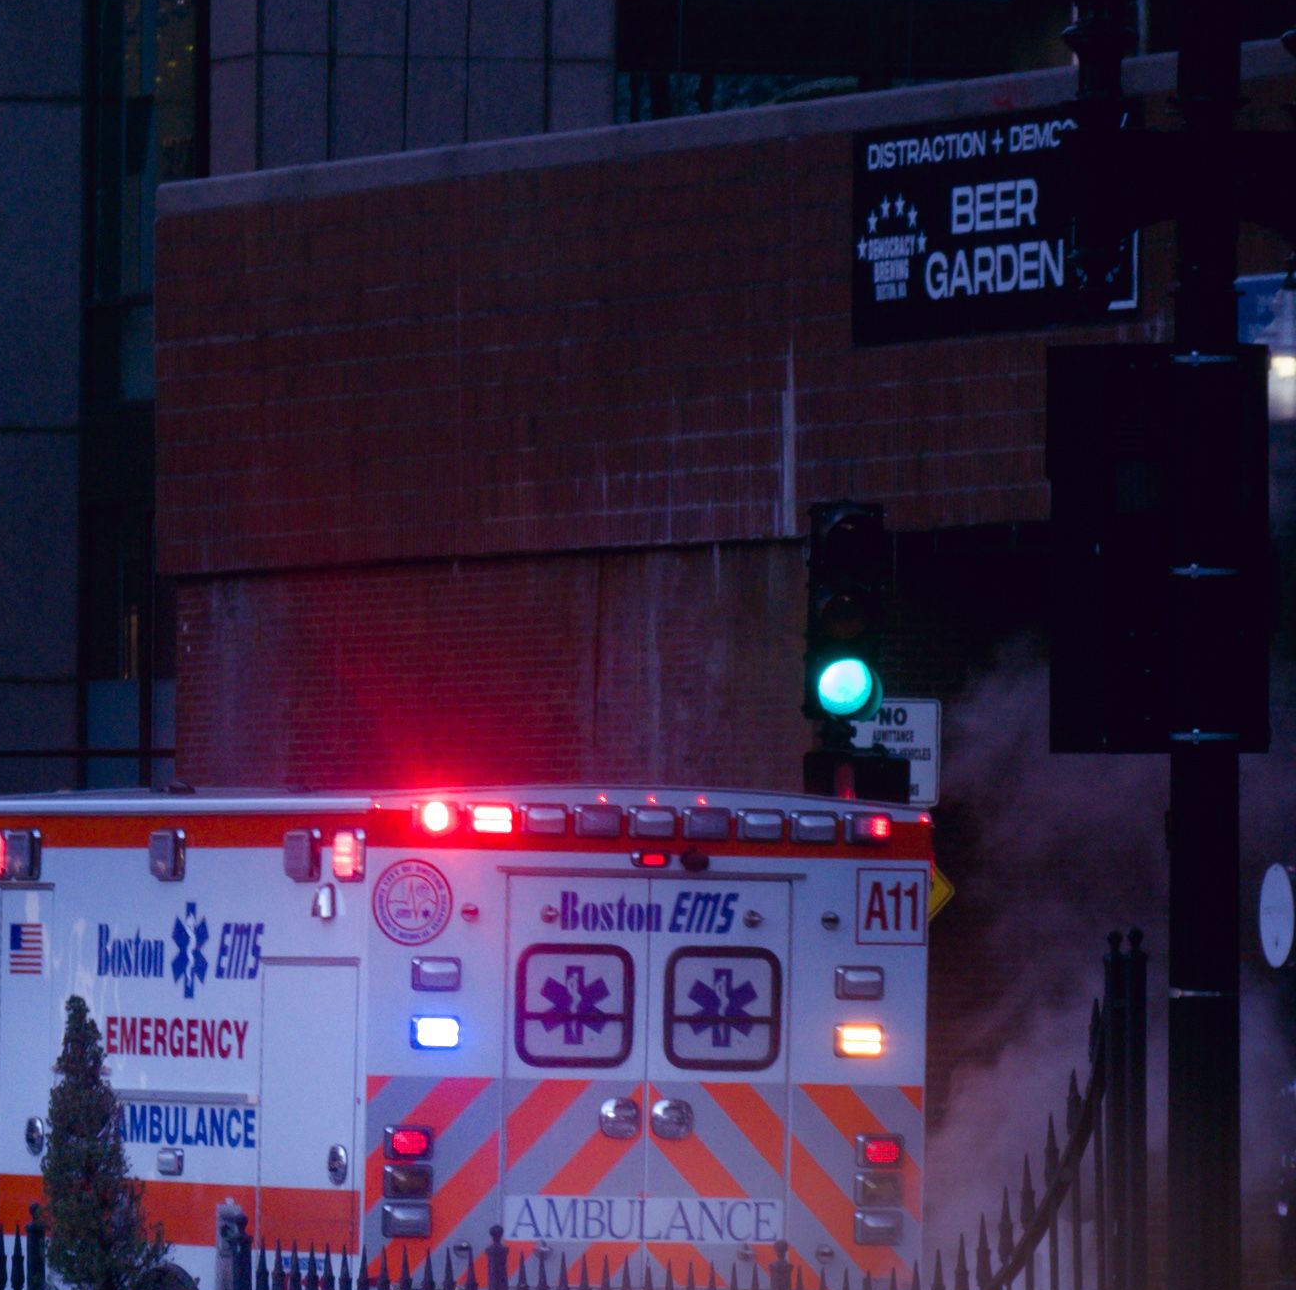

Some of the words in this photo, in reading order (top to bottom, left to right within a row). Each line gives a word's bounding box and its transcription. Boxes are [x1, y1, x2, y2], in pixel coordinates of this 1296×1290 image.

[867, 128, 987, 172] DISTRACTION
[950, 177, 1039, 235] BEER
[924, 238, 1065, 301] GARDEN
[879, 707, 908, 726] NO
[560, 890, 662, 934] Boston
[668, 891, 740, 935] EMS
[864, 881, 919, 932] A11
[97, 922, 165, 978] Boston
[215, 922, 265, 980] EMS
[106, 1016, 249, 1060] EMERGENCY
[510, 1197, 778, 1242] AMBULANCE
